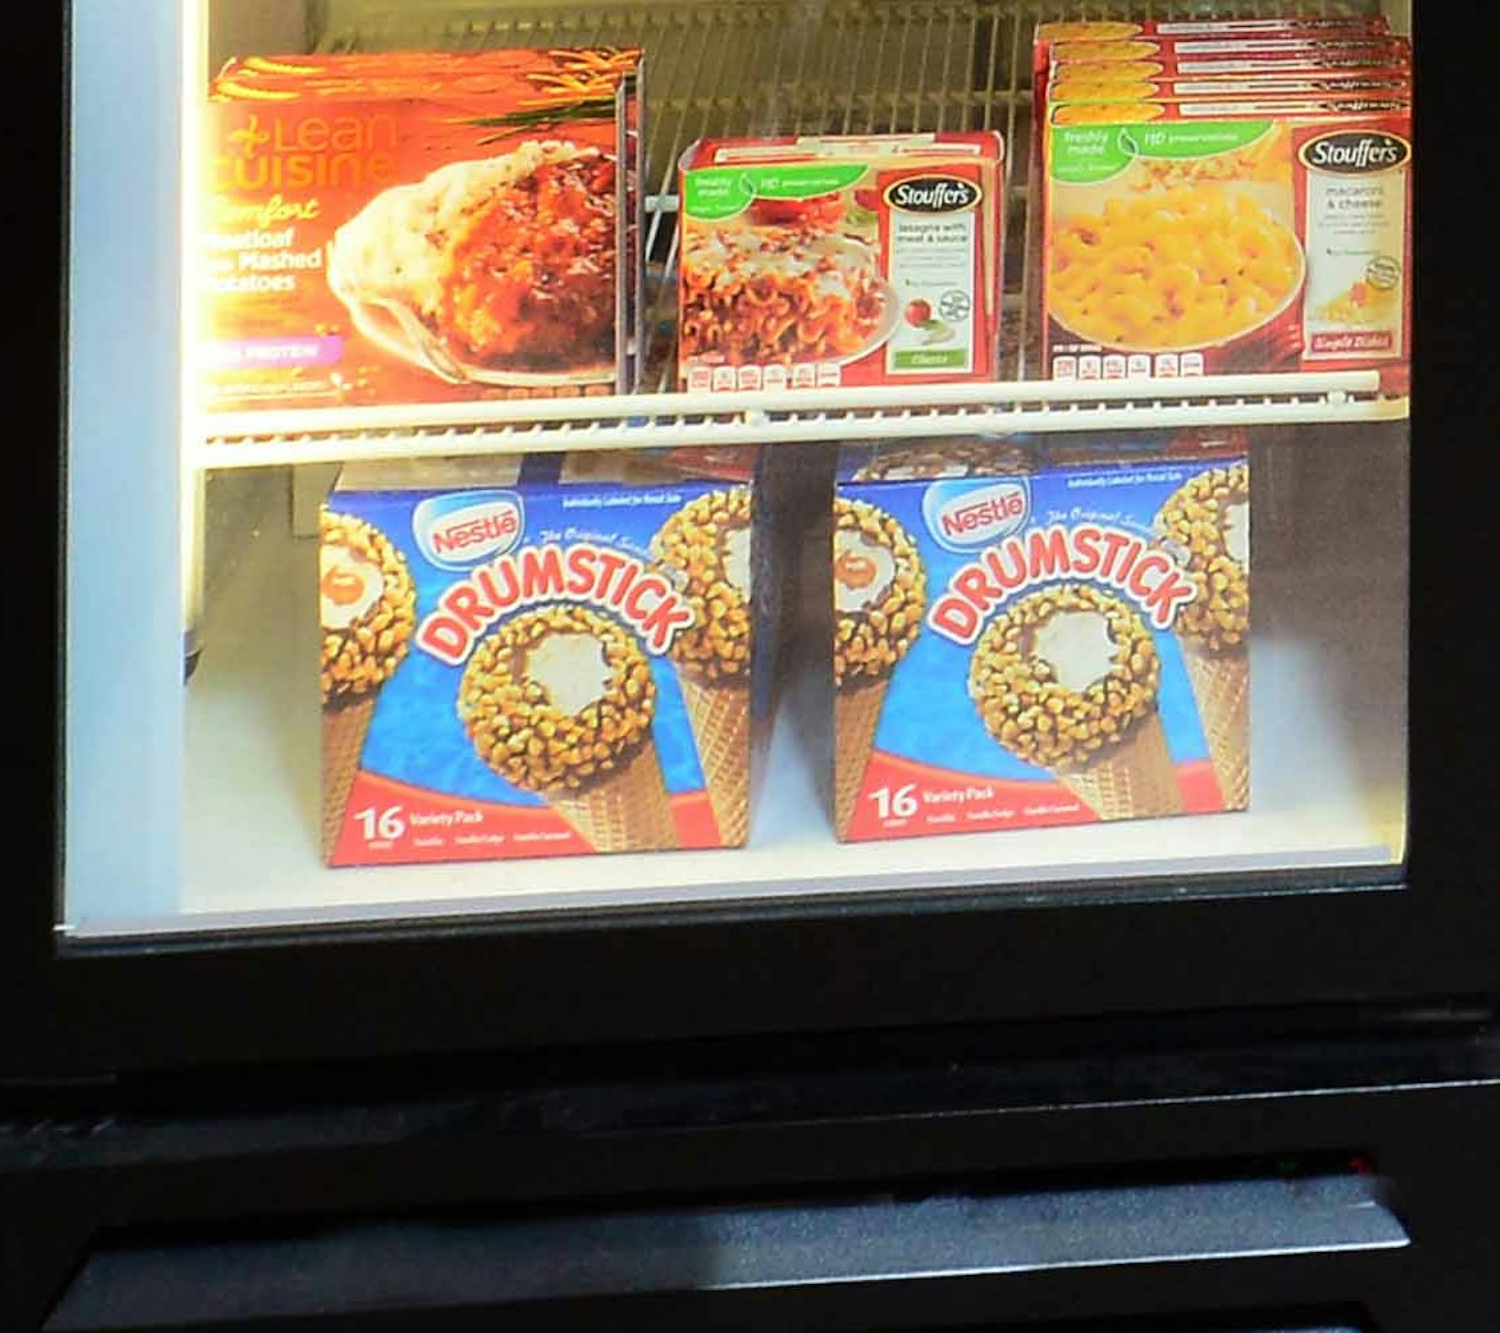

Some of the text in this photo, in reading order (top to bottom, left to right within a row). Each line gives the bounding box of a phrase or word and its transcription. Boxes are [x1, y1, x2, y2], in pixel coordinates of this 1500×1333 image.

[274, 114, 399, 154] Lean
[1311, 140, 1399, 168] Stouffer's
[895, 181, 970, 209] Stouffer's
[928, 525, 1197, 645] DRUMSTICK
[417, 543, 697, 666] DRUMSTICK
[867, 783, 919, 819] 16
[922, 790, 965, 804] Variety
[355, 805, 405, 841] 16
[409, 811, 454, 827] Variety
